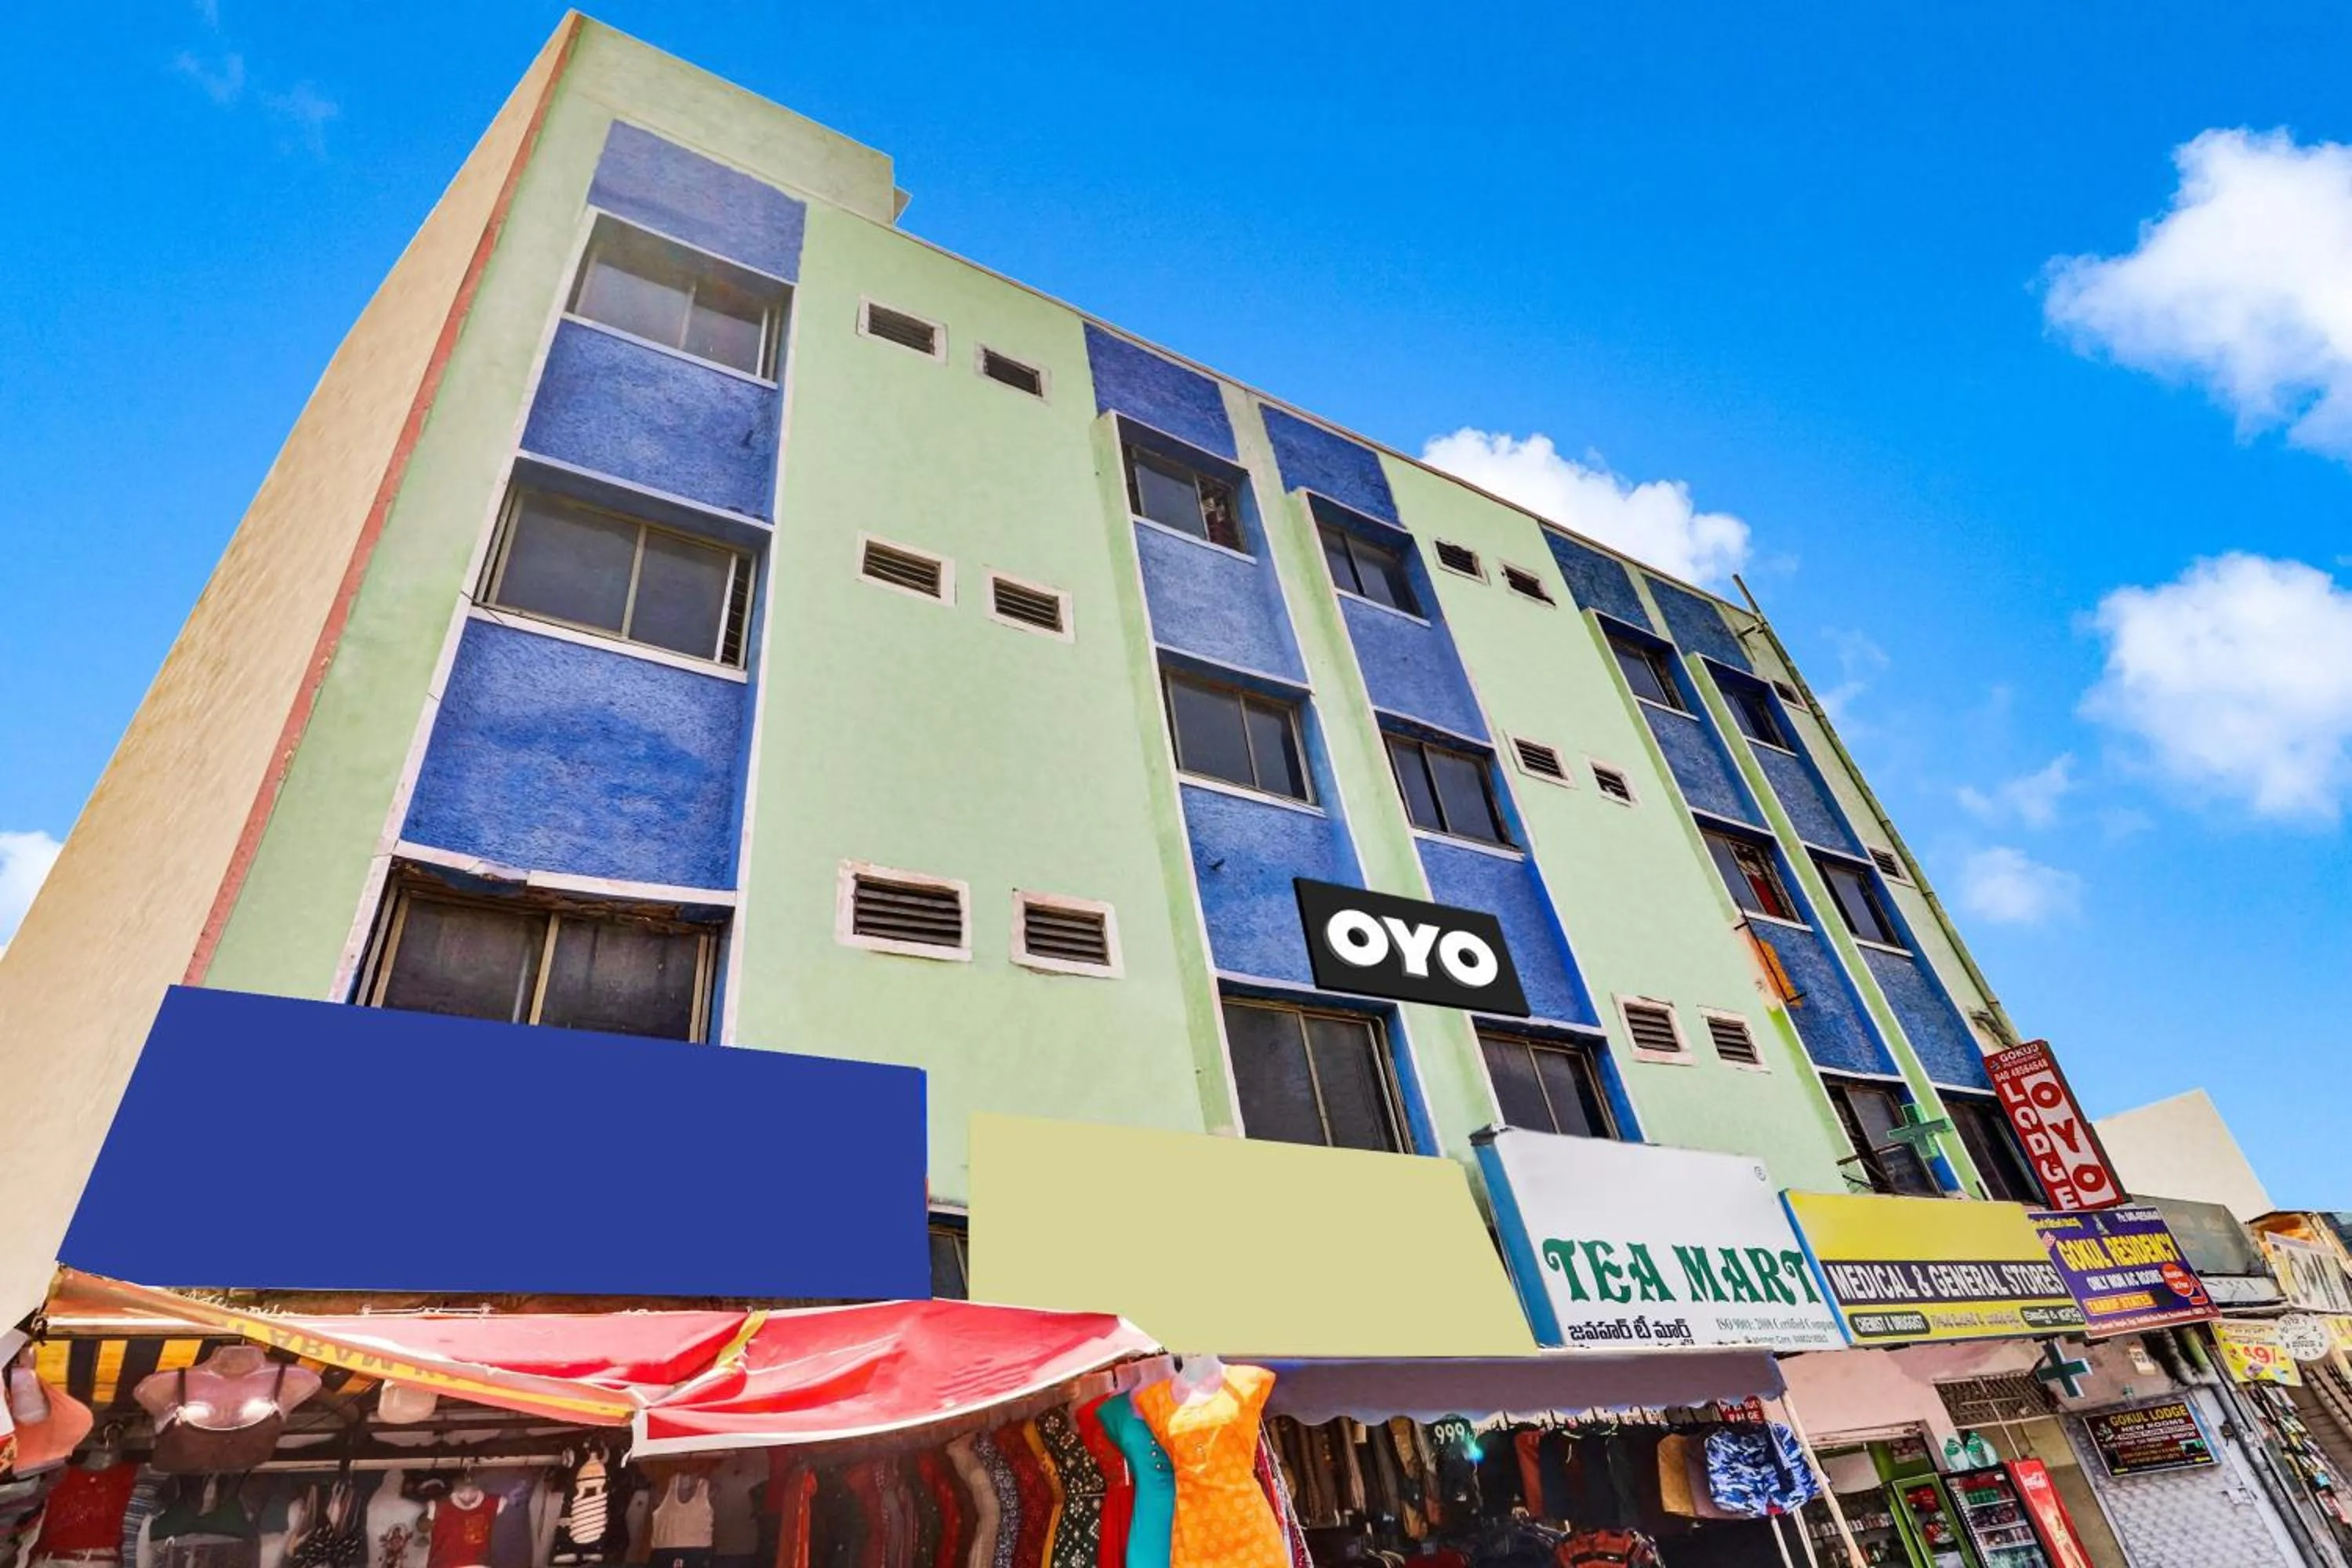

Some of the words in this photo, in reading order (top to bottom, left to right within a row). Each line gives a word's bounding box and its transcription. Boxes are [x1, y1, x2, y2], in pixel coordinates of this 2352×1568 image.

[1324, 909, 1498, 989] OYO
[2002, 1081, 2080, 1210] LODGE
[2031, 1081, 2107, 1192] OYO
[2056, 1238, 2114, 1272] GOKUL
[2102, 1232, 2182, 1267] RESIDENCY
[1542, 1238, 1677, 1303] TEA
[1671, 1243, 1821, 1306] MART
[1827, 1264, 1918, 1300] MEDICAL
[1912, 1264, 1935, 1298] &
[1928, 1264, 2011, 1297] GENERAL
[2000, 1263, 2067, 1294] STORES
[1633, 1315, 1652, 1338] టీ
[1435, 1422, 1465, 1444] 999
[2110, 1411, 2149, 1426] GOKUL
[2148, 1404, 2189, 1421] LODGE
[2147, 1419, 2186, 1429] ROOMS
